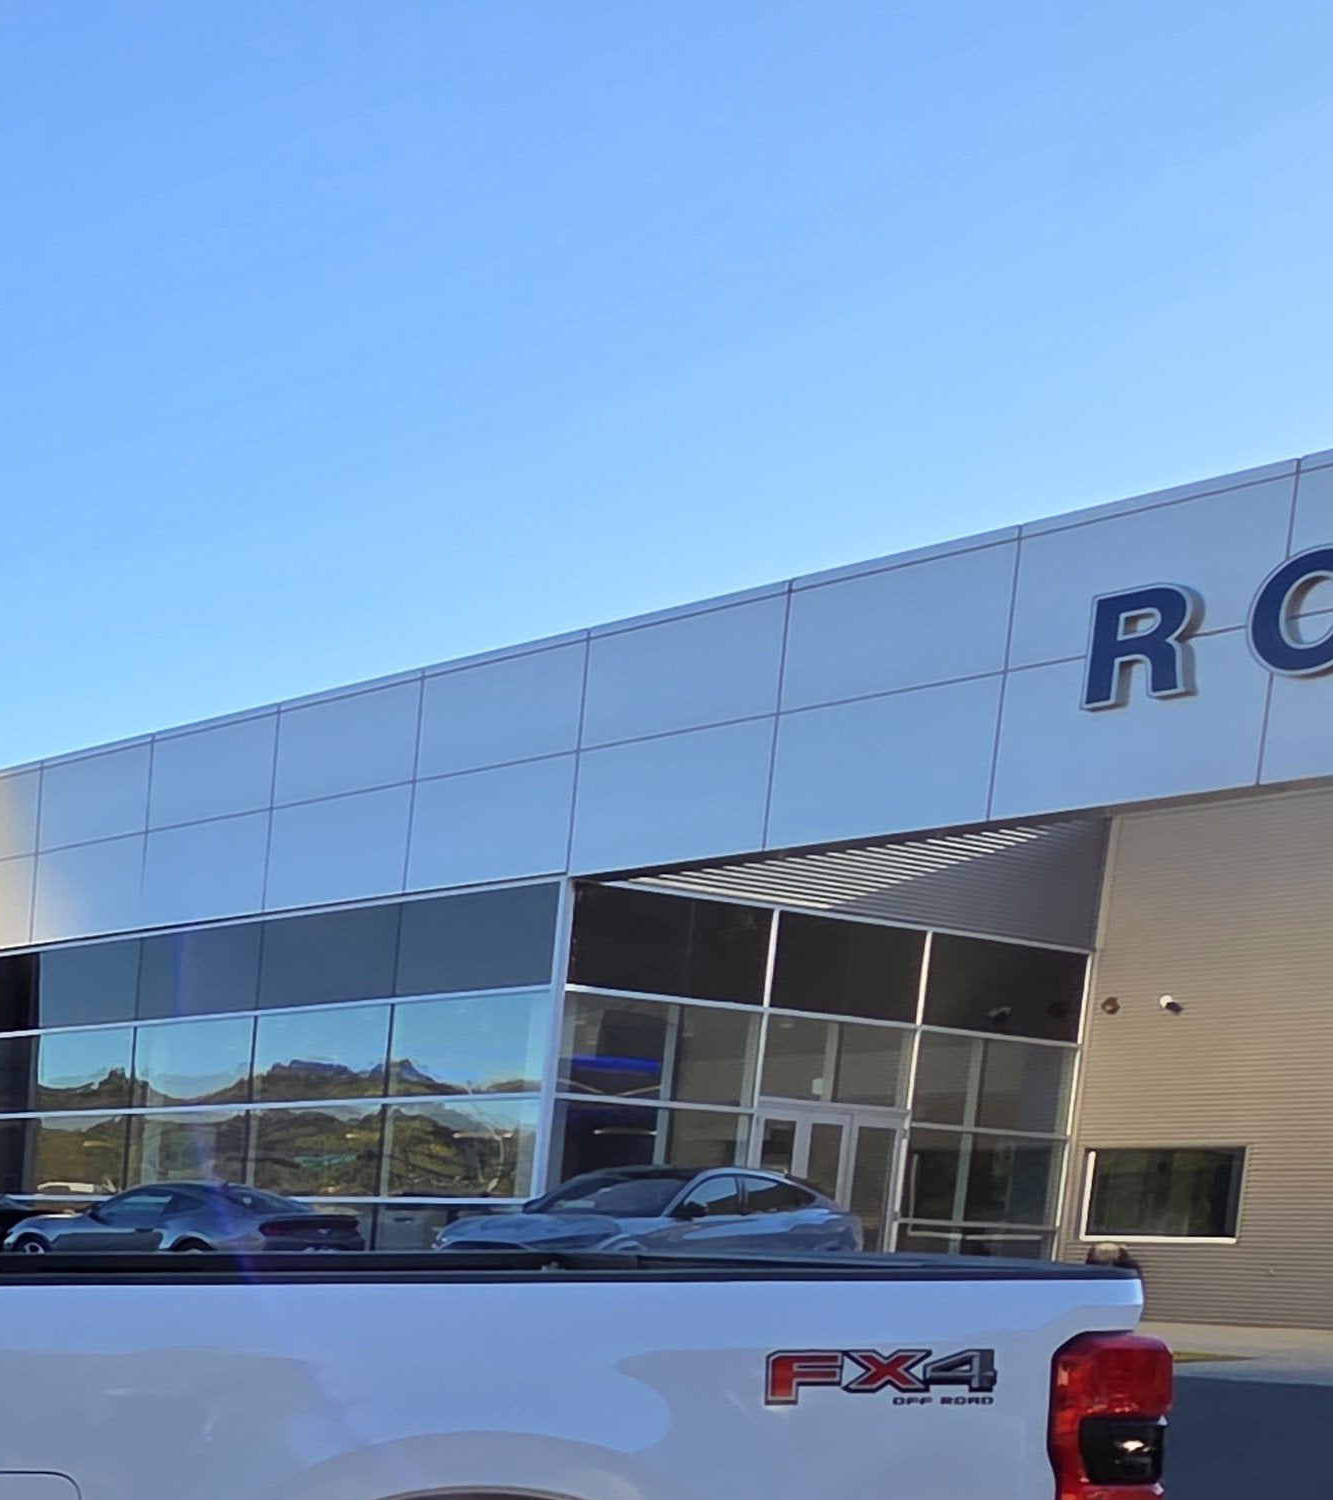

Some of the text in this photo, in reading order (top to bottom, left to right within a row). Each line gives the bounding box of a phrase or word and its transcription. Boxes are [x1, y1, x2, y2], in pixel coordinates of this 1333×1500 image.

[765, 1349, 997, 1405] FX4
[892, 1396, 996, 1406] OFF ROAD
